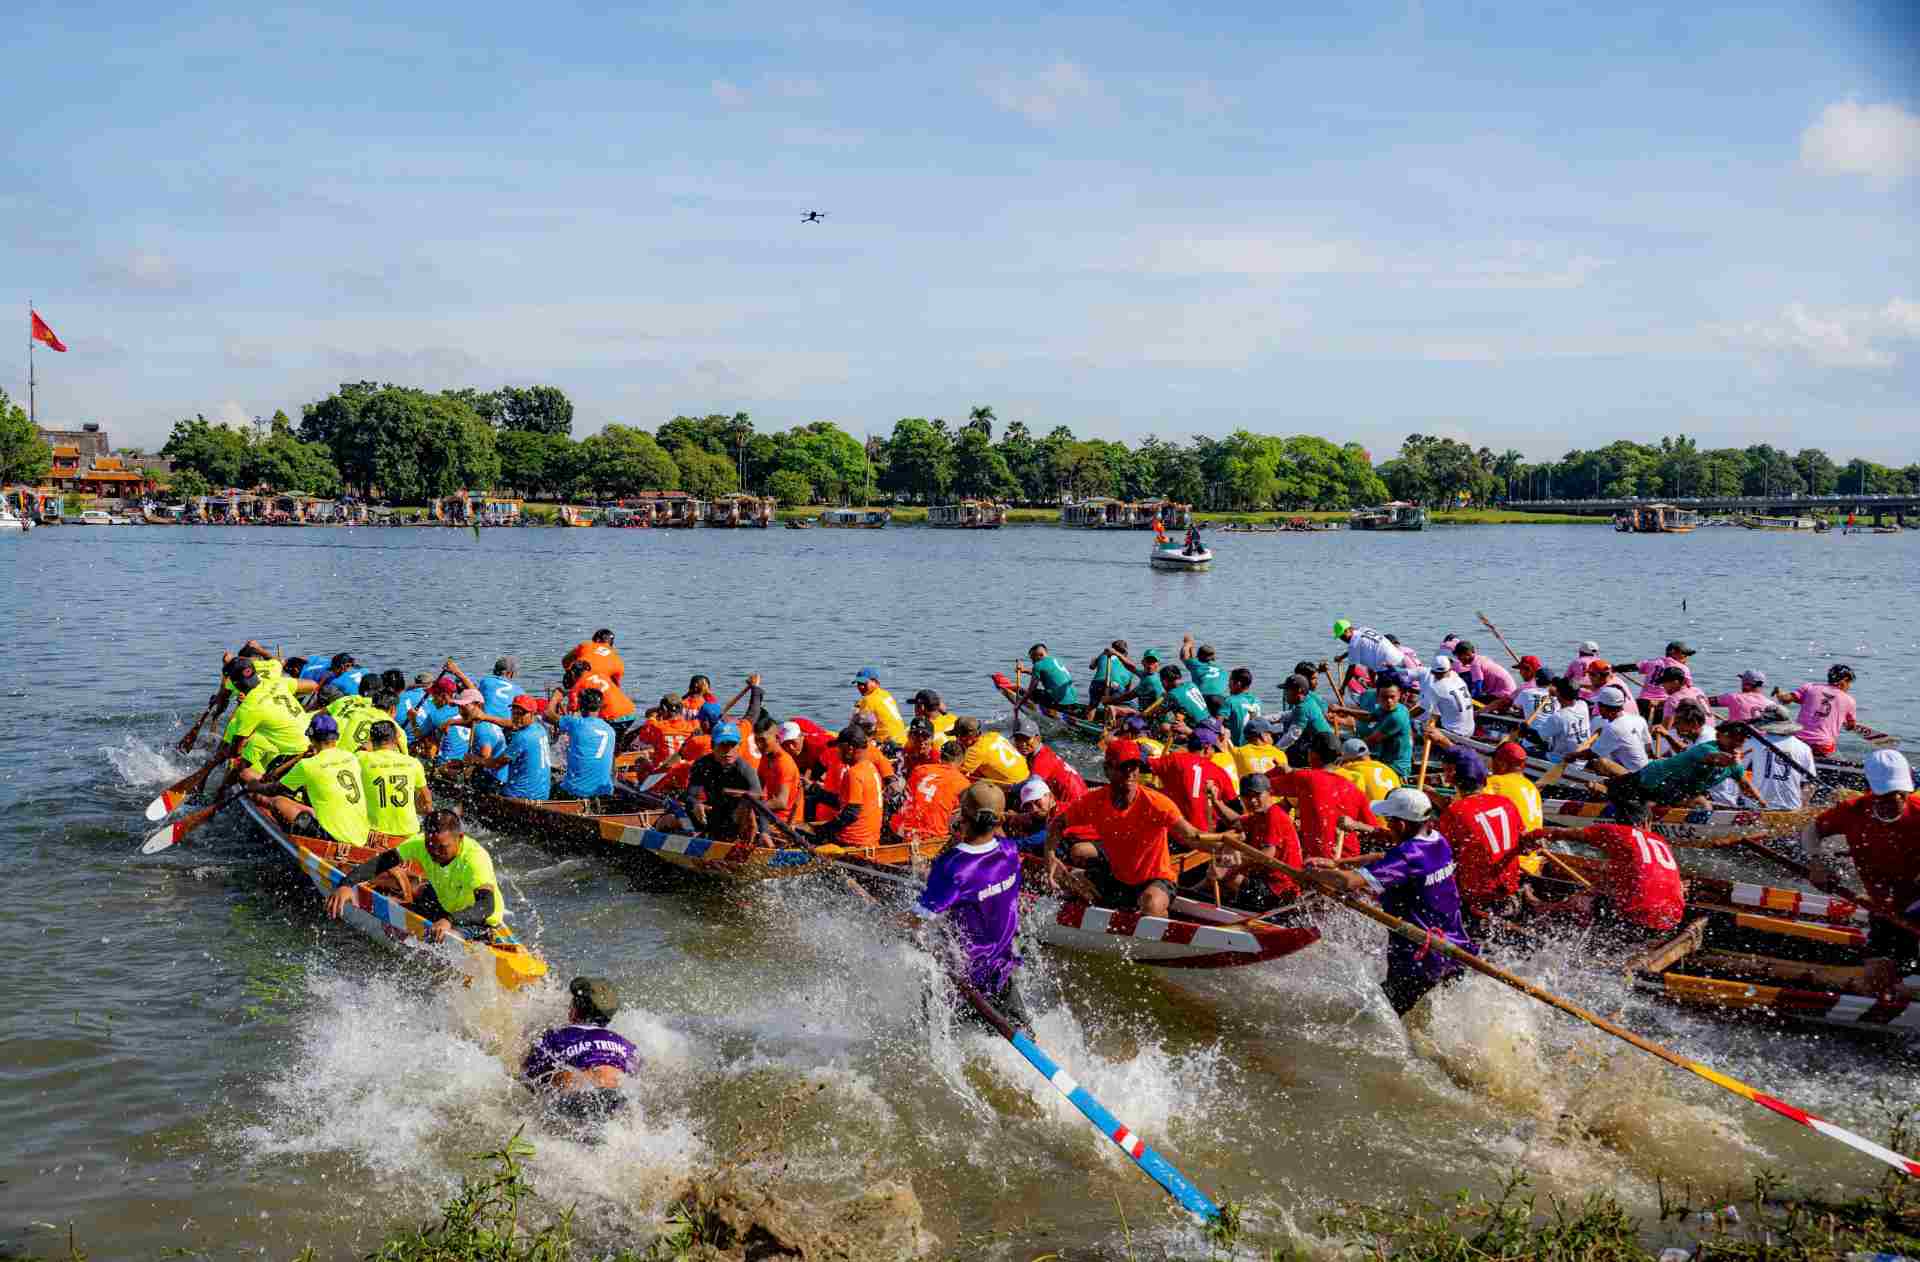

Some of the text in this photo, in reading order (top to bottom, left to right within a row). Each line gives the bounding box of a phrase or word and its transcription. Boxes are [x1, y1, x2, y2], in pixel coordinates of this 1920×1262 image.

[594, 729, 608, 759] 7
[1764, 747, 1792, 781] 15
[336, 769, 361, 805] 9
[372, 774, 409, 809] 13
[1474, 806, 1511, 854] 17
[1631, 828, 1678, 871] 10
